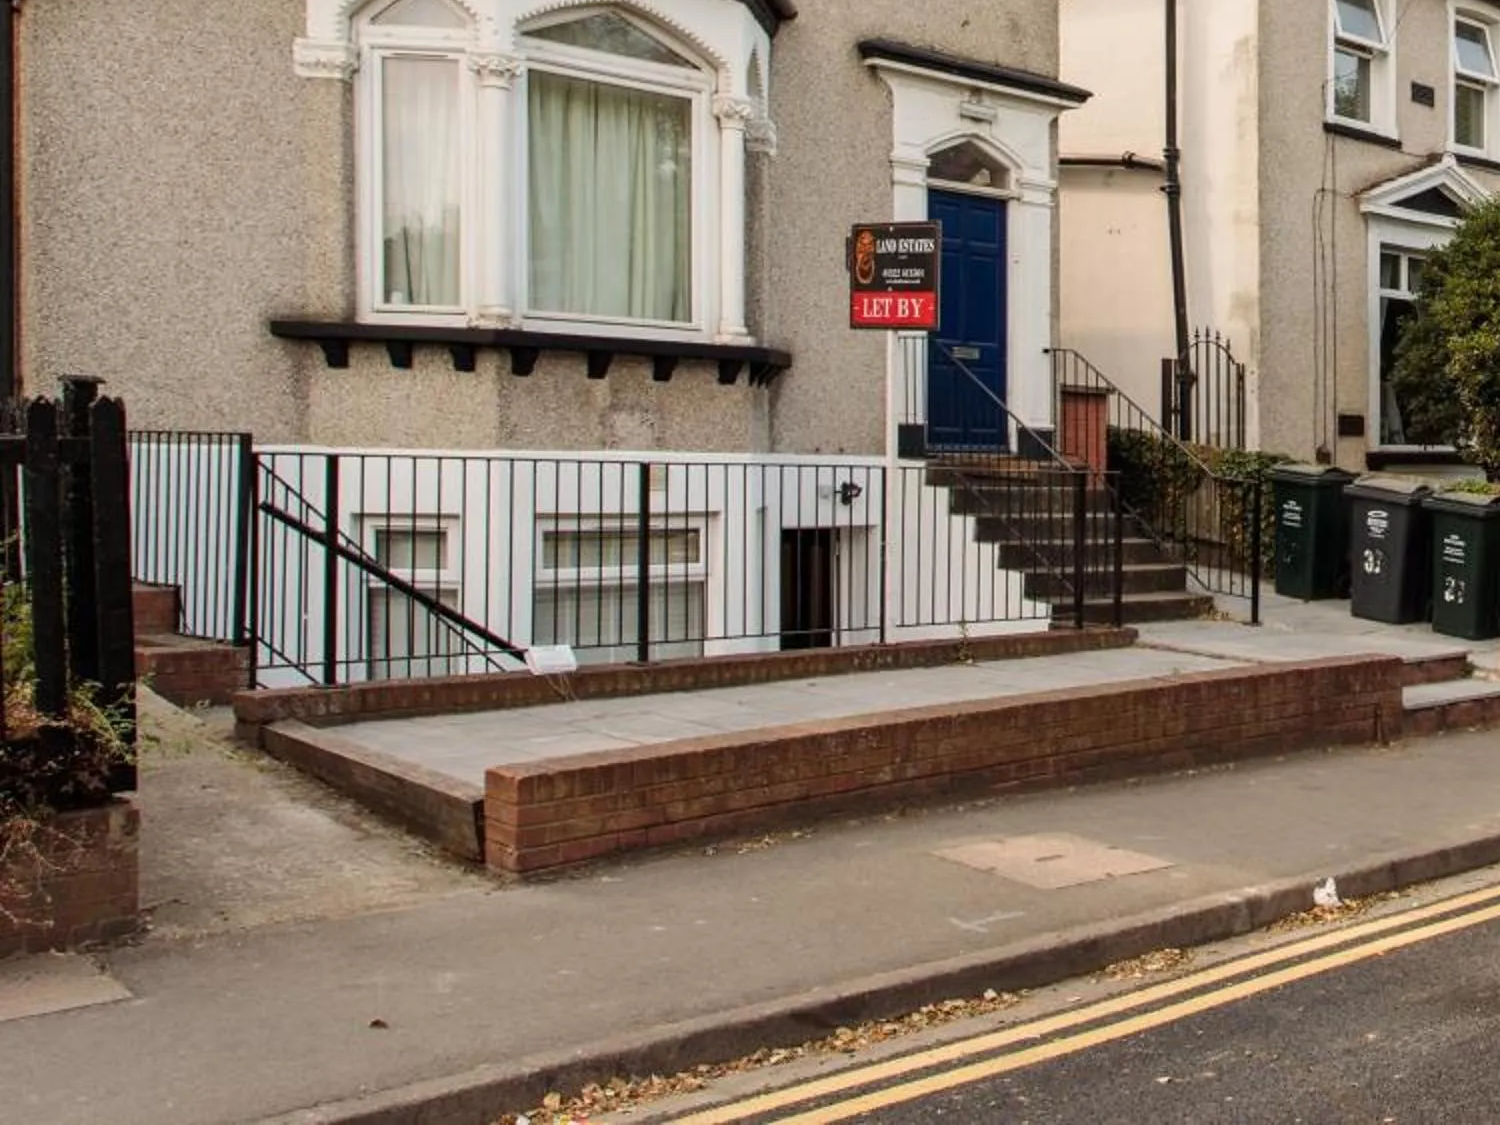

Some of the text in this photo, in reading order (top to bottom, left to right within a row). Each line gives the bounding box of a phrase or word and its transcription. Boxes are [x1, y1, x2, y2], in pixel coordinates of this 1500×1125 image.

[876, 238, 936, 254] LAND ESTATES
[863, 298, 924, 318] LET BY
